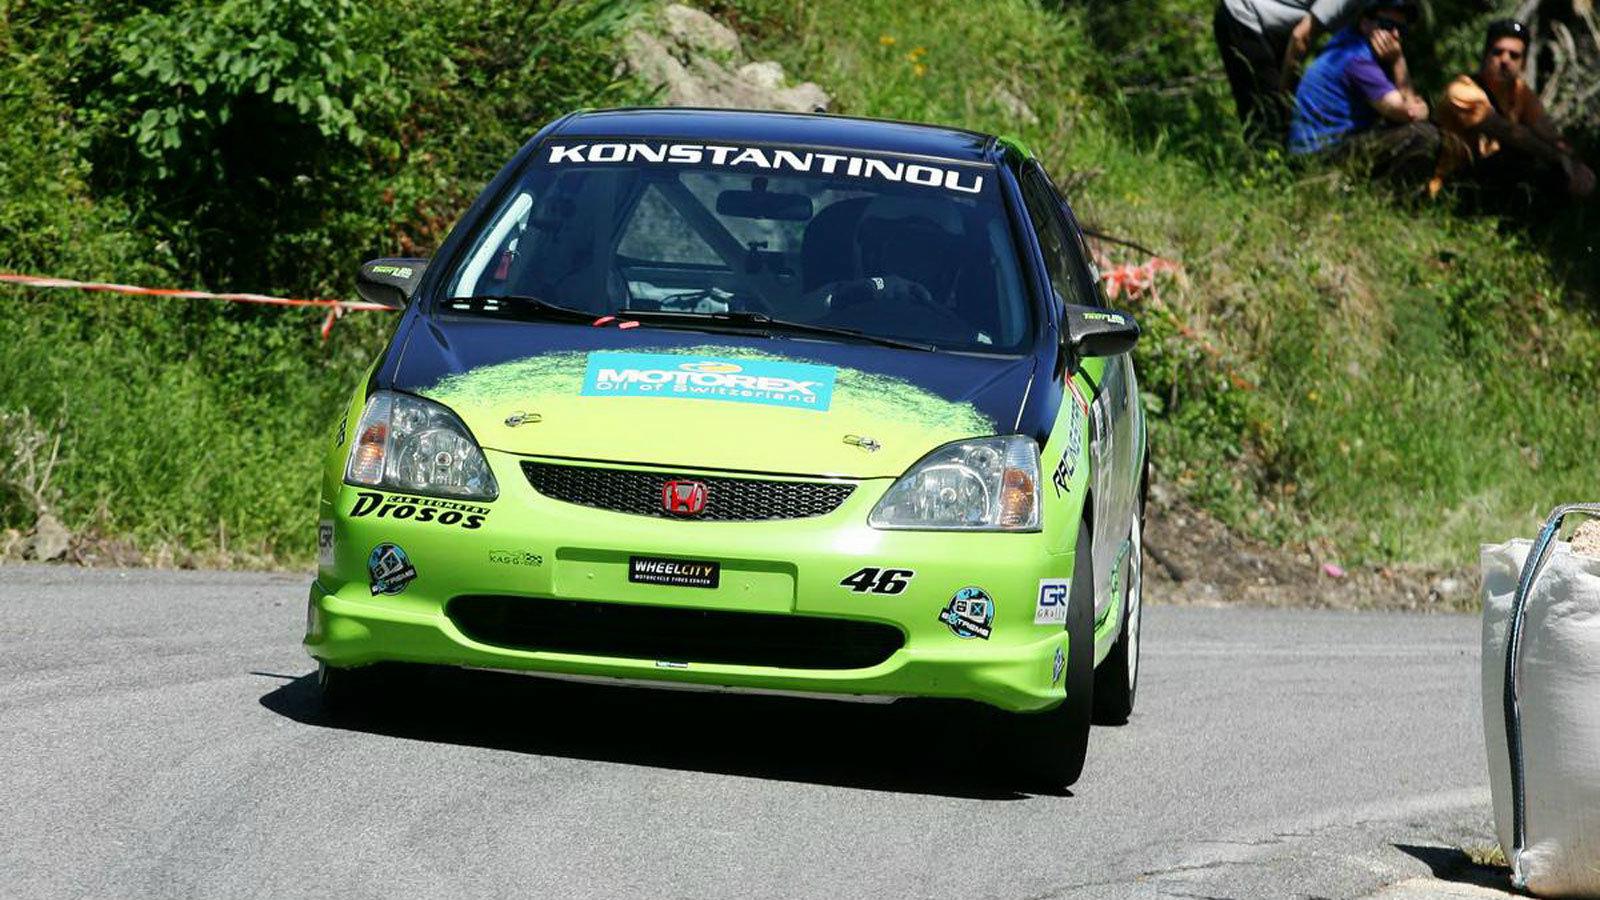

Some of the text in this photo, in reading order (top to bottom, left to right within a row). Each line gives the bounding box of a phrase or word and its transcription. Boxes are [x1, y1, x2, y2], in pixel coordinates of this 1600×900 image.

[548, 143, 984, 194] KONSTANTINOU
[596, 368, 815, 396] MOTOREX
[596, 381, 817, 404] Oil of Switzerland
[350, 492, 486, 529] Drosos
[840, 567, 914, 594] 46
[1040, 584, 1067, 606] GR
